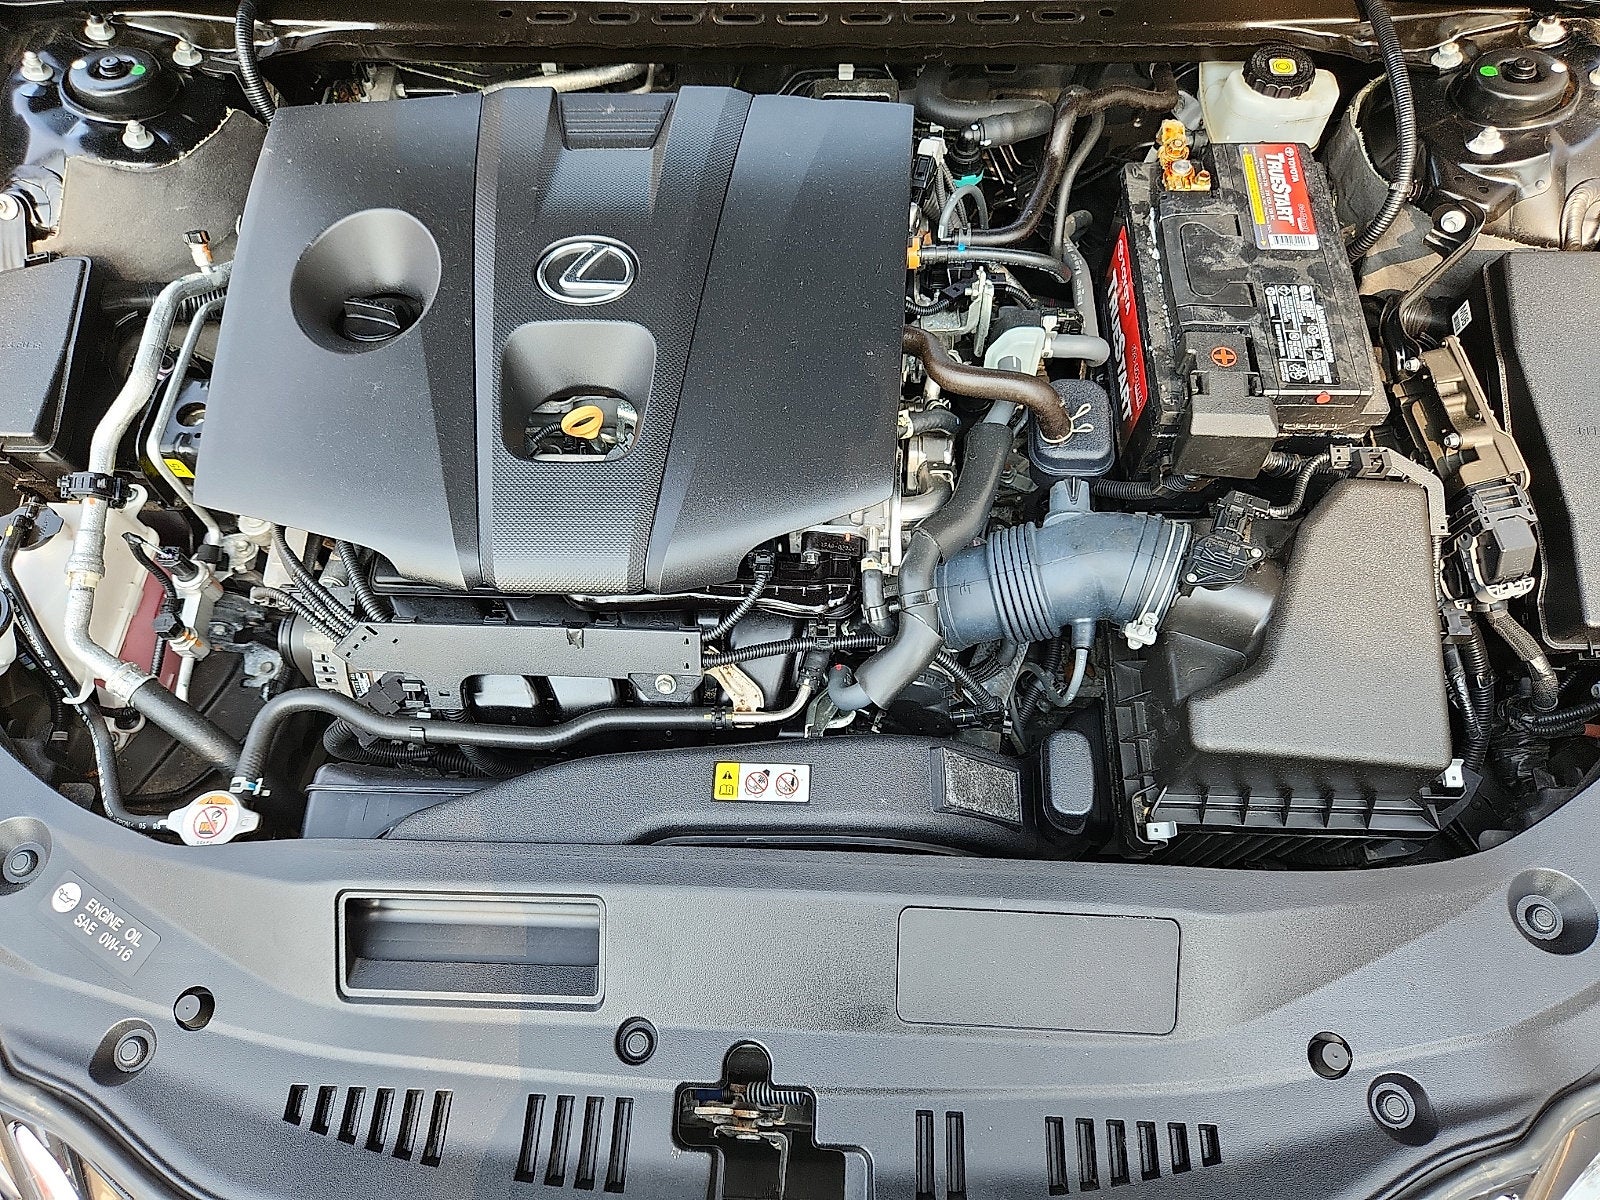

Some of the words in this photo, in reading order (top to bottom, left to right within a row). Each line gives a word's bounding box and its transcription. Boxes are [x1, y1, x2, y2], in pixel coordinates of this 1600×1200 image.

[1287, 157, 1299, 183] TOYOTA
[73, 913, 99, 936] SAE
[98, 931, 134, 962] 0W-16
[84, 897, 125, 932] ENGINE
[124, 927, 143, 948] OIL
